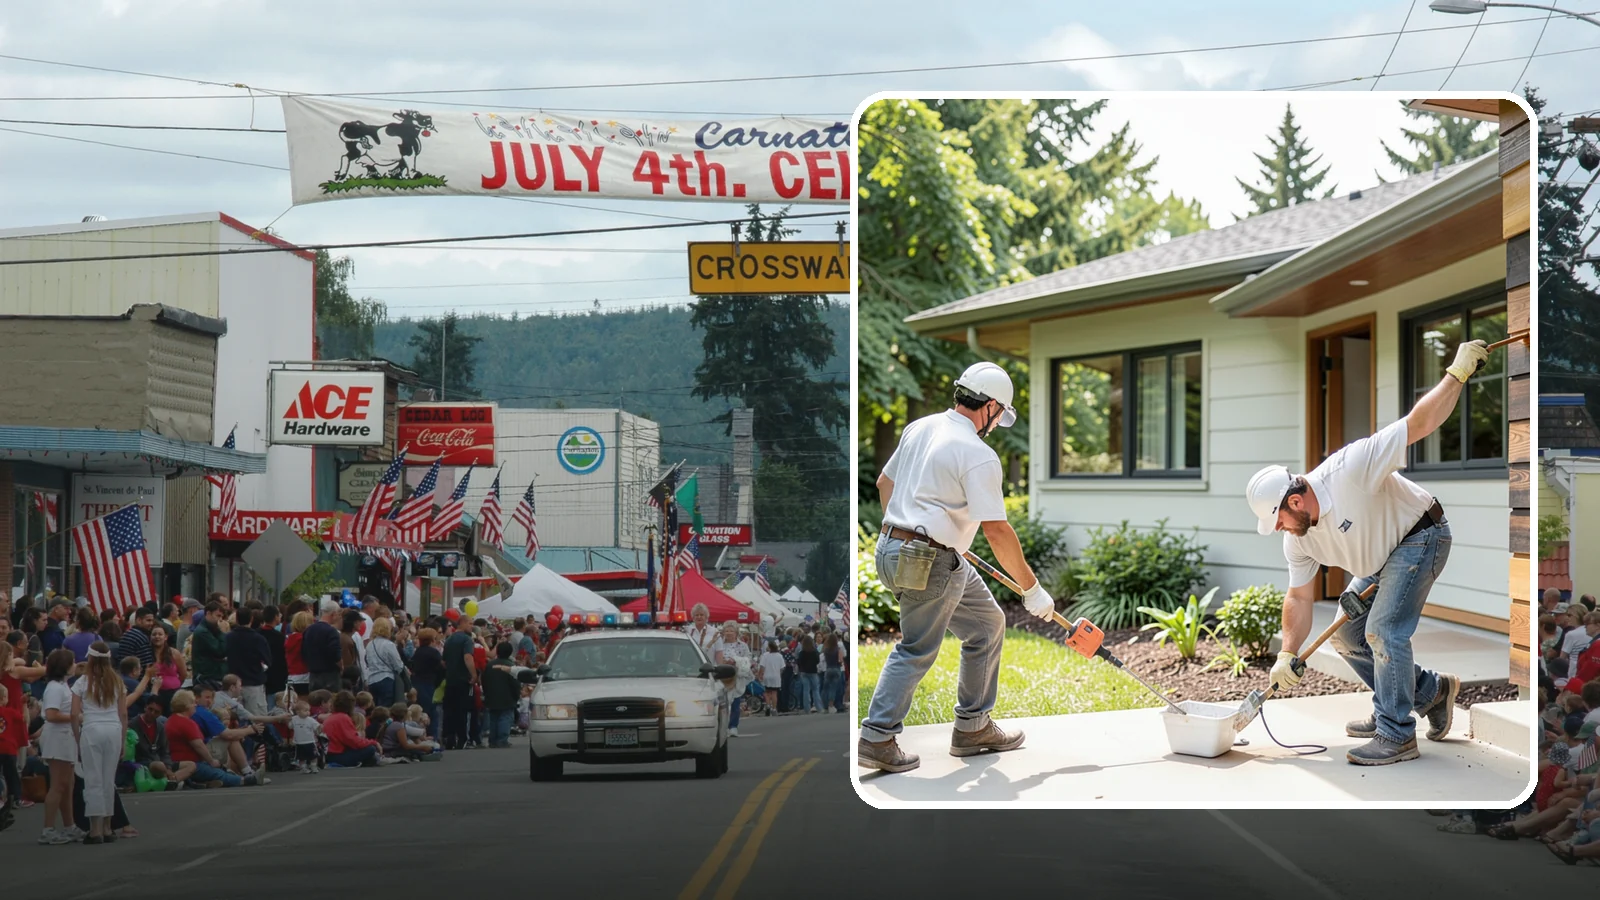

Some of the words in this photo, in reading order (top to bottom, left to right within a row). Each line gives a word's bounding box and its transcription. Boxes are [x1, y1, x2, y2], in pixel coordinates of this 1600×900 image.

[695, 121, 850, 150] Carnat
[481, 141, 604, 192] JULY
[632, 150, 746, 198] 4th.
[697, 254, 850, 280] CROSSWA
[282, 380, 373, 420] ACE
[406, 409, 453, 422] CEDAR
[283, 421, 370, 436] Hardware
[416, 428, 477, 447] Coca-Cola
[353, 467, 384, 478] Simpl
[83, 486, 94, 494] St.
[96, 485, 124, 494] Vincent
[126, 486, 136, 494] de
[138, 486, 155, 495] Paul
[688, 526, 741, 535] CRNATION
[699, 535, 730, 543] GLASS
